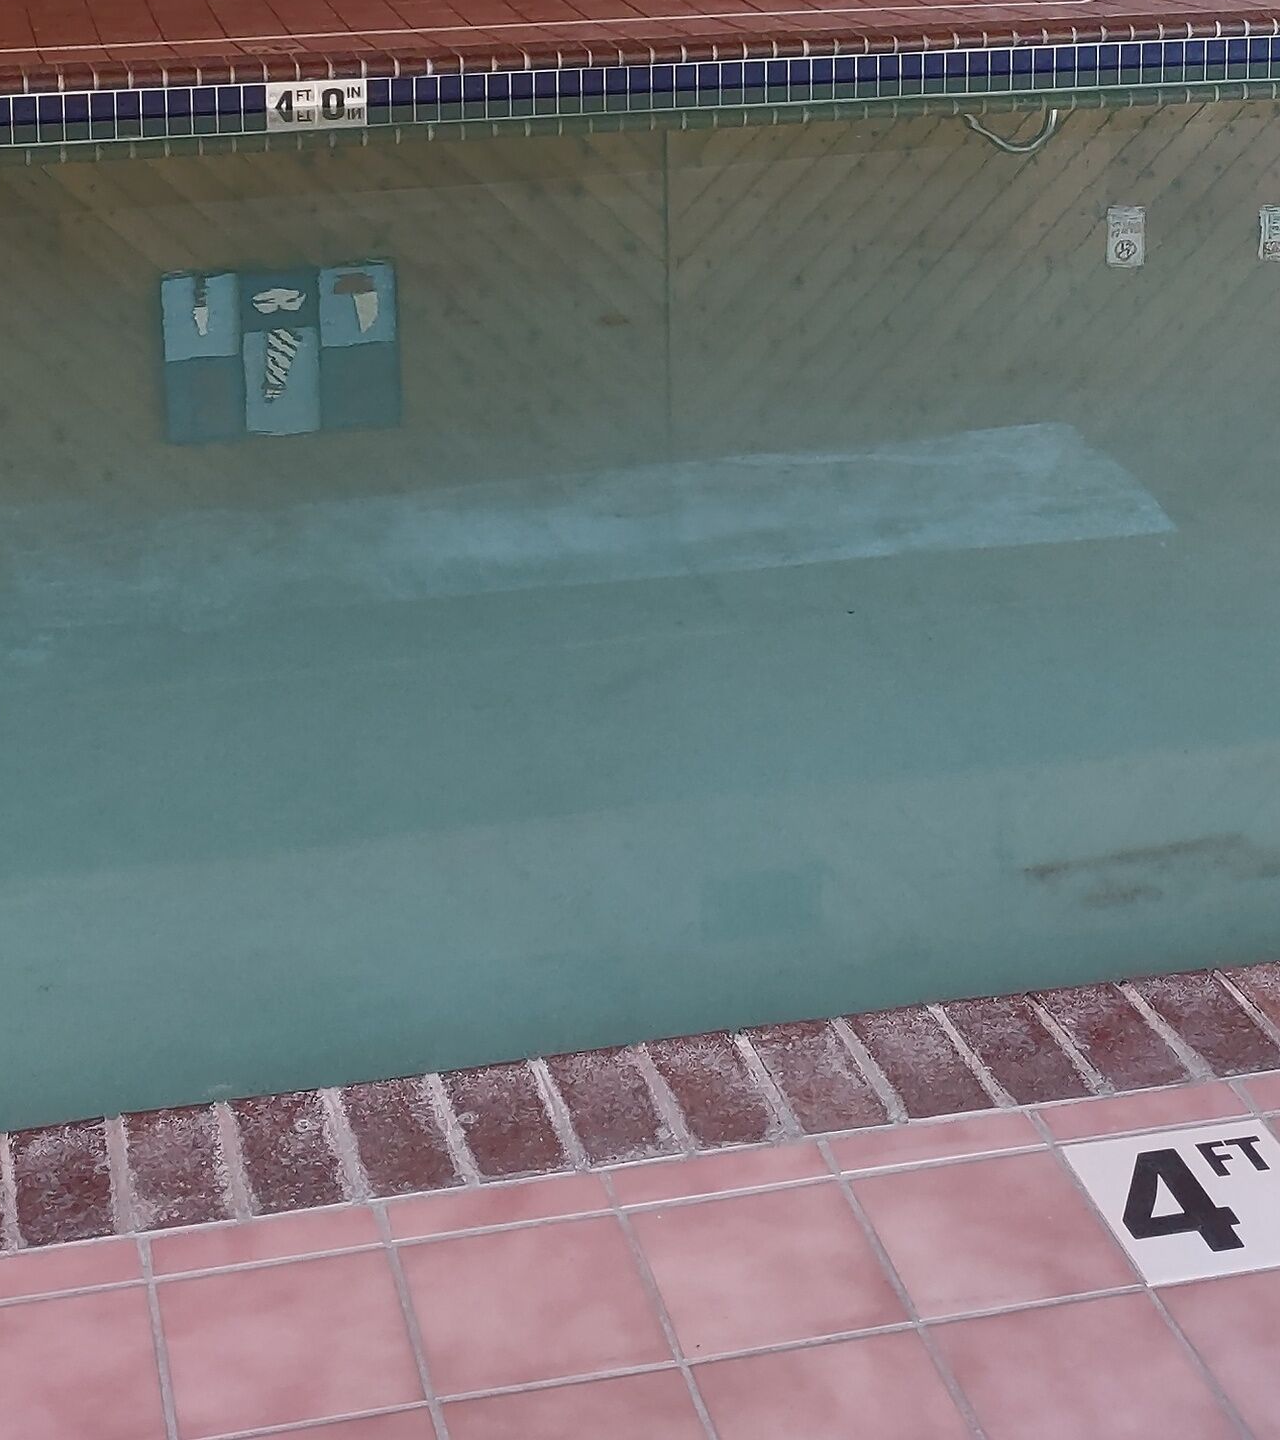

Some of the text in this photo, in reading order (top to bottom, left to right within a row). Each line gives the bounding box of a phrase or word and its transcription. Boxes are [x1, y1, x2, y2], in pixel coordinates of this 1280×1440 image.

[296, 89, 312, 102] FT
[322, 88, 345, 120] 0
[347, 86, 361, 99] IN
[1123, 1136, 1270, 1252] 4 FT
